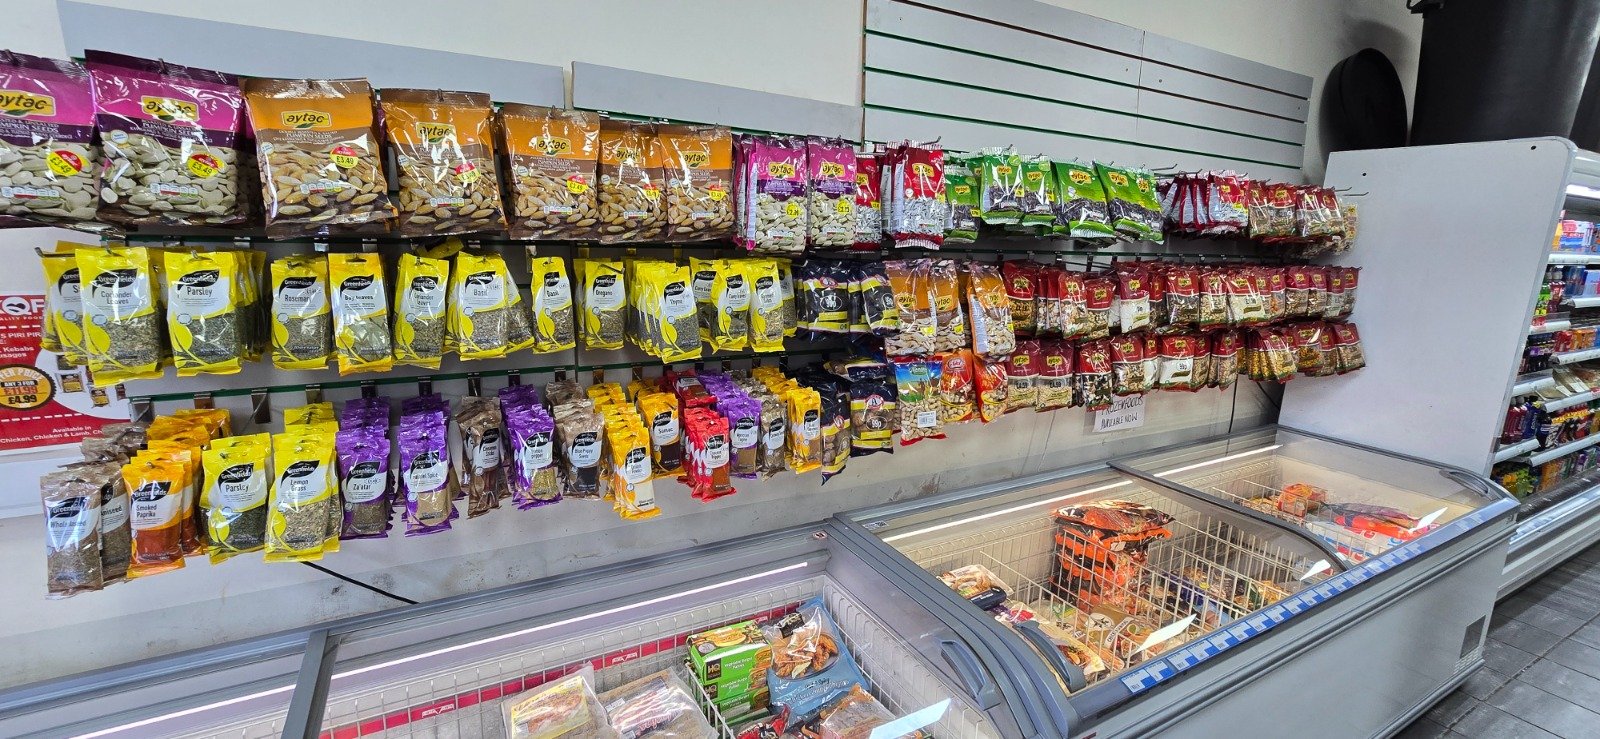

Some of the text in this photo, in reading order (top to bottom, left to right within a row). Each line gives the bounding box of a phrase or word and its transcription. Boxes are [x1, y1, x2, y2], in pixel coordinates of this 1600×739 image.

[286, 112, 325, 125] aytac
[49, 155, 71, 174] £3.49
[336, 156, 354, 166] £3.49
[191, 163, 213, 175] £3.49
[98, 274, 136, 283] Greenields
[187, 287, 213, 297] Parsley
[473, 289, 488, 297] Basil
[17, 367, 43, 382] PRICE
[8, 395, 37, 405] £4.99
[1124, 412, 1138, 423] NOW
[871, 420, 882, 429] 99p
[33, 433, 63, 441] Chicken
[70, 430, 92, 438] Lamb,
[221, 469, 252, 481] Greenfields
[225, 483, 249, 493] Parsley
[290, 479, 309, 487] Lemon
[134, 489, 168, 498] Greenields
[707, 664, 721, 672] HQ
